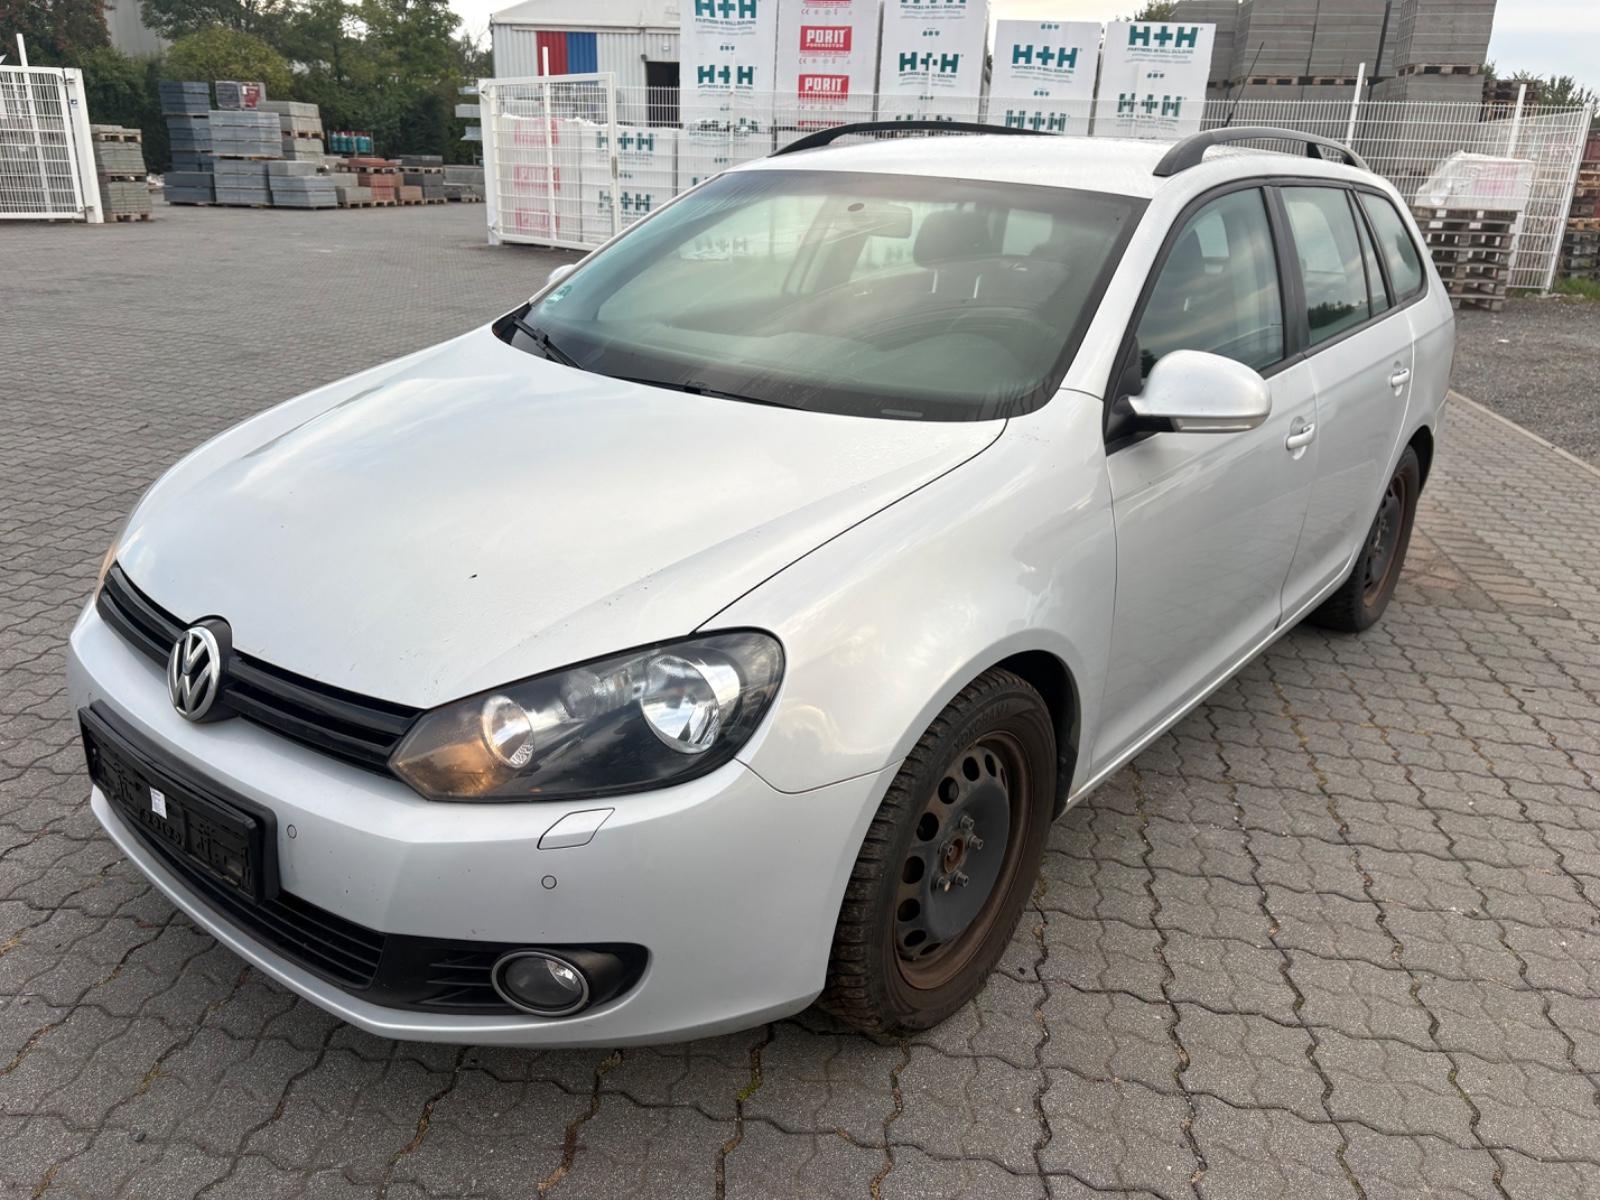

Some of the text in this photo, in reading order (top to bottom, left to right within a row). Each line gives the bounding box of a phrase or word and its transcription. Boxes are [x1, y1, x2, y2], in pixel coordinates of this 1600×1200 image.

[806, 29, 846, 43] PORIT
[1128, 25, 1199, 48] H+H
[899, 51, 960, 74] H+H
[1012, 44, 1079, 68] H+H
[697, 64, 755, 85] H+H
[804, 77, 845, 91] PORIT
[1117, 93, 1183, 118] H+H
